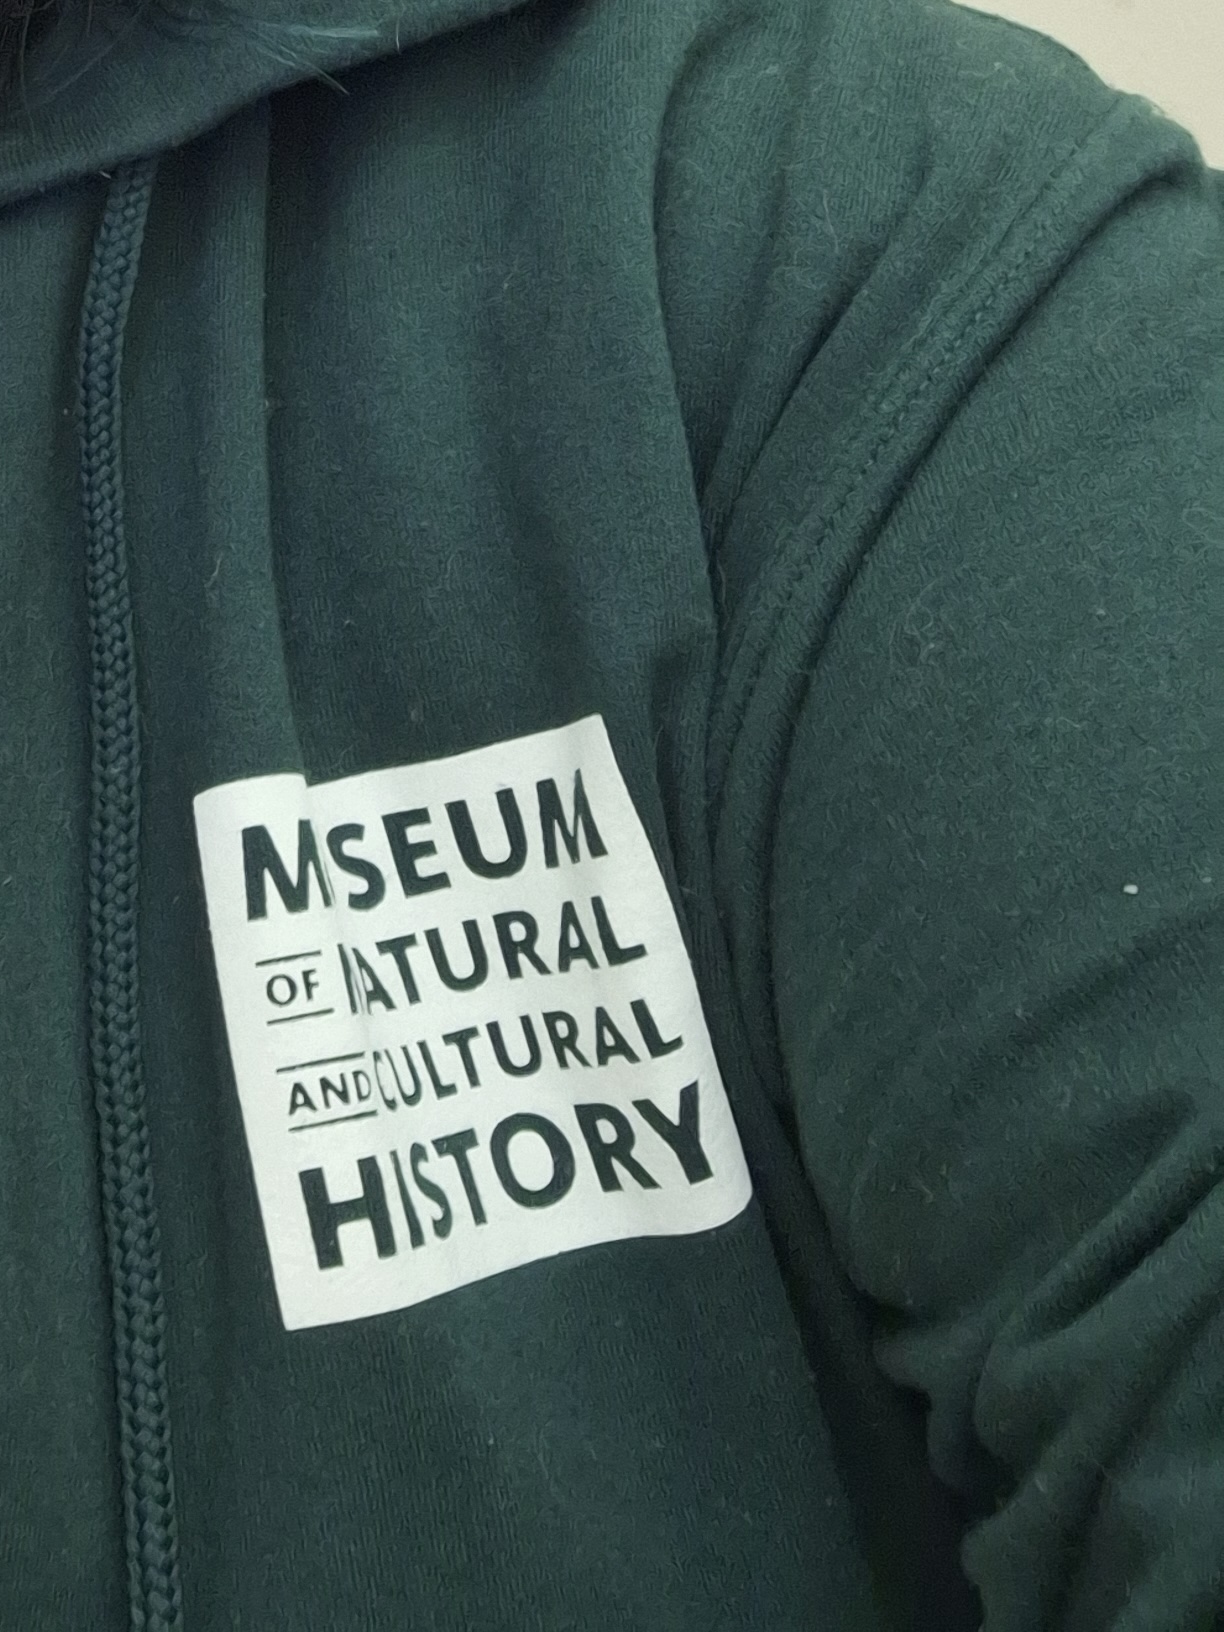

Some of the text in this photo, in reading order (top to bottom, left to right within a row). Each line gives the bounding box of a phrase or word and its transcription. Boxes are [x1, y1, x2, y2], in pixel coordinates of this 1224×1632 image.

[241, 768, 609, 923] MSEUM
[265, 968, 320, 1008] OF
[287, 999, 685, 1117] AND CULTURAL
[297, 1079, 715, 1272] HISTORY
